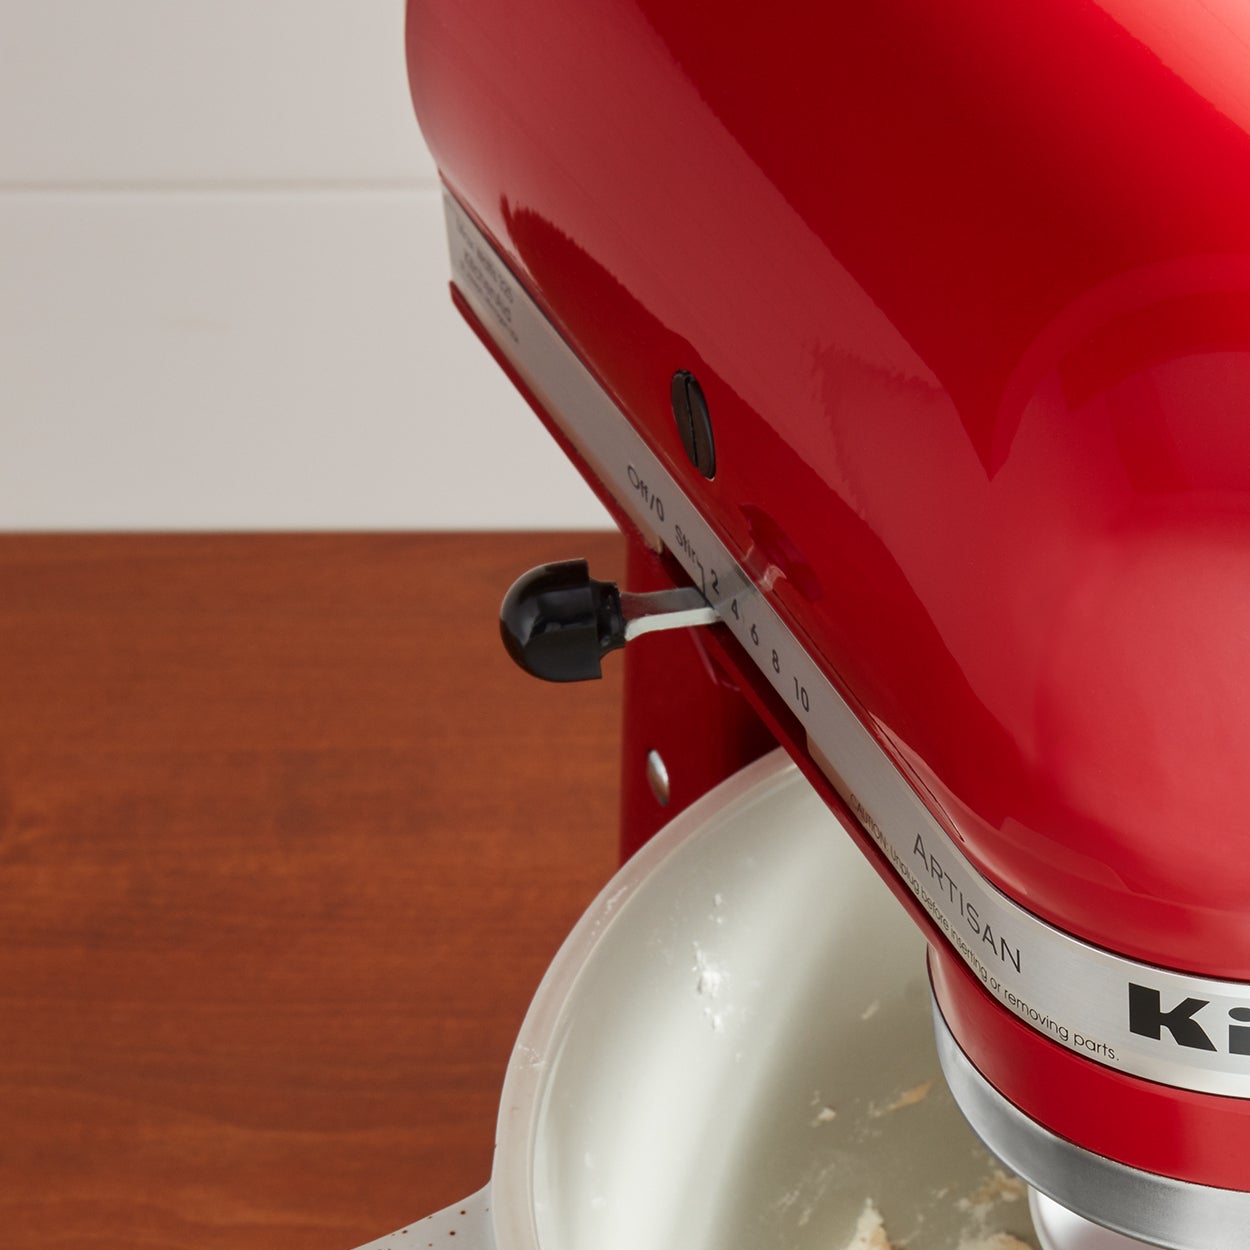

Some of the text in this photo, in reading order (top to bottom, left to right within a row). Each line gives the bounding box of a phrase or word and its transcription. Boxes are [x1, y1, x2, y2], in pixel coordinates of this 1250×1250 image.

[627, 465, 809, 712] Off/0 Stir 2 4 6 8 10
[849, 793, 1120, 1061] CAUTION: Unplug before inserting or removing parts.
[913, 833, 1022, 973] ARTISAN
